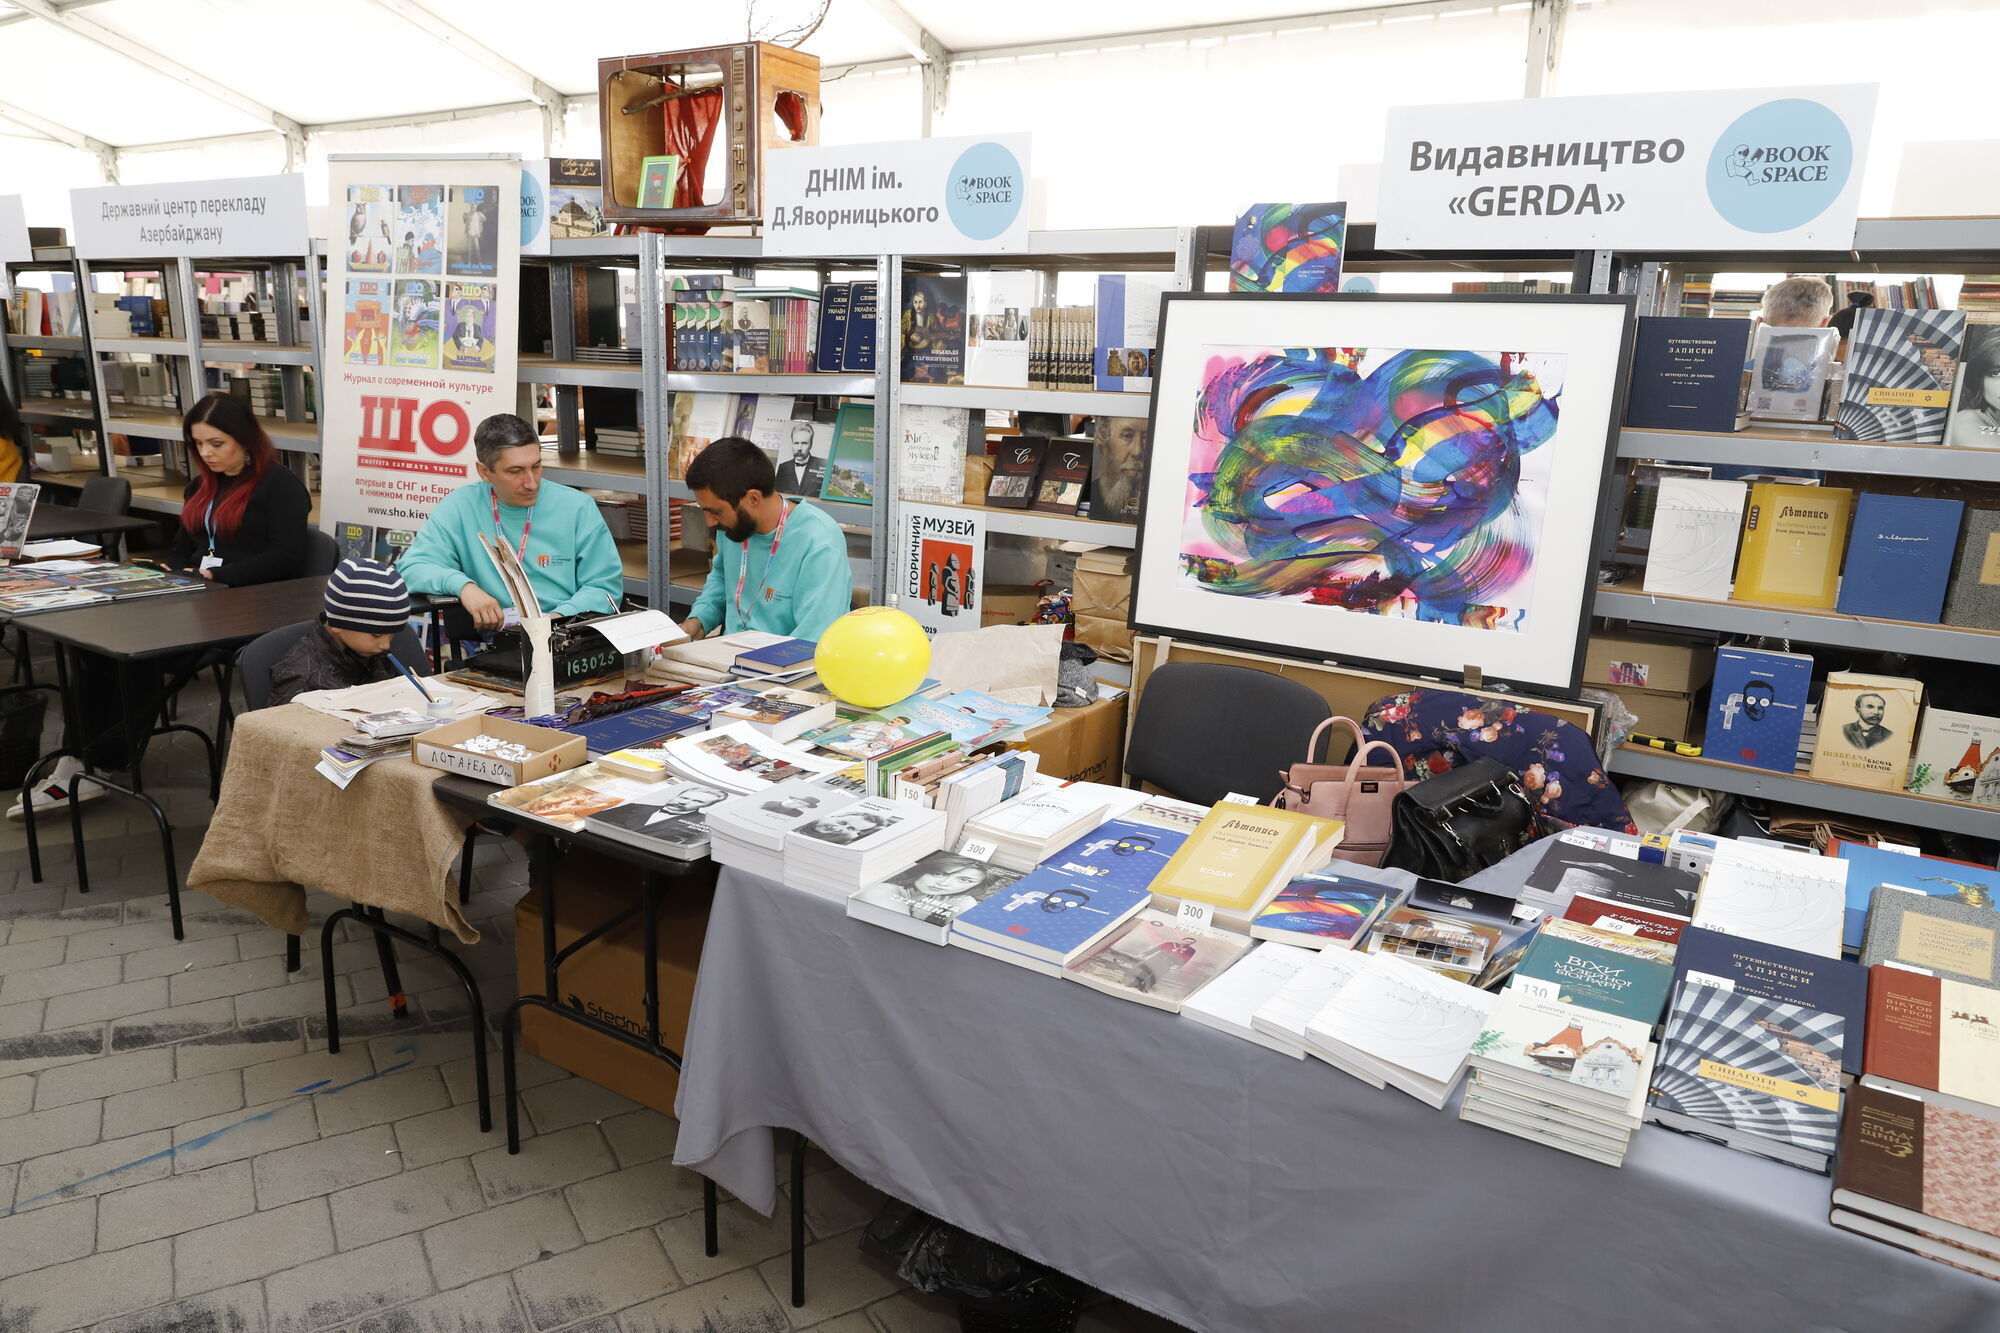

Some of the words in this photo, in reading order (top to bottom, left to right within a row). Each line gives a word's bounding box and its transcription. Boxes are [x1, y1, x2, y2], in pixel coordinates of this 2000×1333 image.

[1409, 138, 1686, 177] Видавництво
[1762, 144, 1833, 163] BOOK
[805, 167, 866, 198] ДНІМ
[871, 165, 904, 190] ім.
[976, 175, 1012, 189] BOOK
[1760, 165, 1830, 183] SPACE
[975, 190, 1012, 204] SPACE
[1447, 183, 1626, 217] «GERDA»
[101, 199, 161, 222] Державний
[163, 200, 197, 218] центр
[200, 196, 267, 217] перекладу
[772, 205, 939, 231] Д.Яворницького
[139, 224, 223, 245] Азербайджану
[358, 281, 379, 292] ШО
[461, 285, 482, 296] ШО
[1668, 346, 1714, 355] ЗАПИСКИ
[343, 373, 376, 385] Журнал
[384, 377, 446, 390] современной
[449, 382, 494, 393] культуре
[358, 394, 471, 456] ШО
[360, 457, 390, 466] СМОТРЕТЬ
[392, 460, 429, 470] СЛУШАТЬ
[432, 464, 464, 474] ЧИТАТЬ
[355, 478, 387, 489] впервые
[388, 481, 394, 489] в
[396, 480, 418, 491] СНГ
[420, 484, 428, 492] и
[359, 488, 364, 496] в
[365, 489, 403, 500] книжном
[1779, 506, 1830, 520] Лѣтопись
[346, 525, 363, 536] ШО
[923, 517, 975, 537] МУЗЕЙ
[389, 531, 413, 543] ШО
[909, 515, 921, 599] ІСТОРИЧНИЙ
[567, 650, 616, 678] 163025
[903, 787, 919, 801] 150
[1221, 819, 1279, 836] Лѣтопись
[966, 843, 986, 855] 300
[1567, 837, 1586, 846] 250
[1183, 904, 1203, 919] 300
[1607, 922, 1623, 931] 50
[1702, 922, 1726, 933] 350
[1732, 953, 1814, 977] ПУТЕШЕСТВЕННЫЯ
[1733, 960, 1811, 985] ЗАПИСКИ
[1522, 983, 1548, 999] 130
[1695, 977, 1721, 989] 350
[1784, 996, 1816, 1009] ХЕРСОНА
[1886, 998, 1933, 1014] ВІКТОР
[1886, 1004, 1933, 1020] ПЕТРОВ
[1709, 1063, 1777, 1087] СИНАГОГИ
